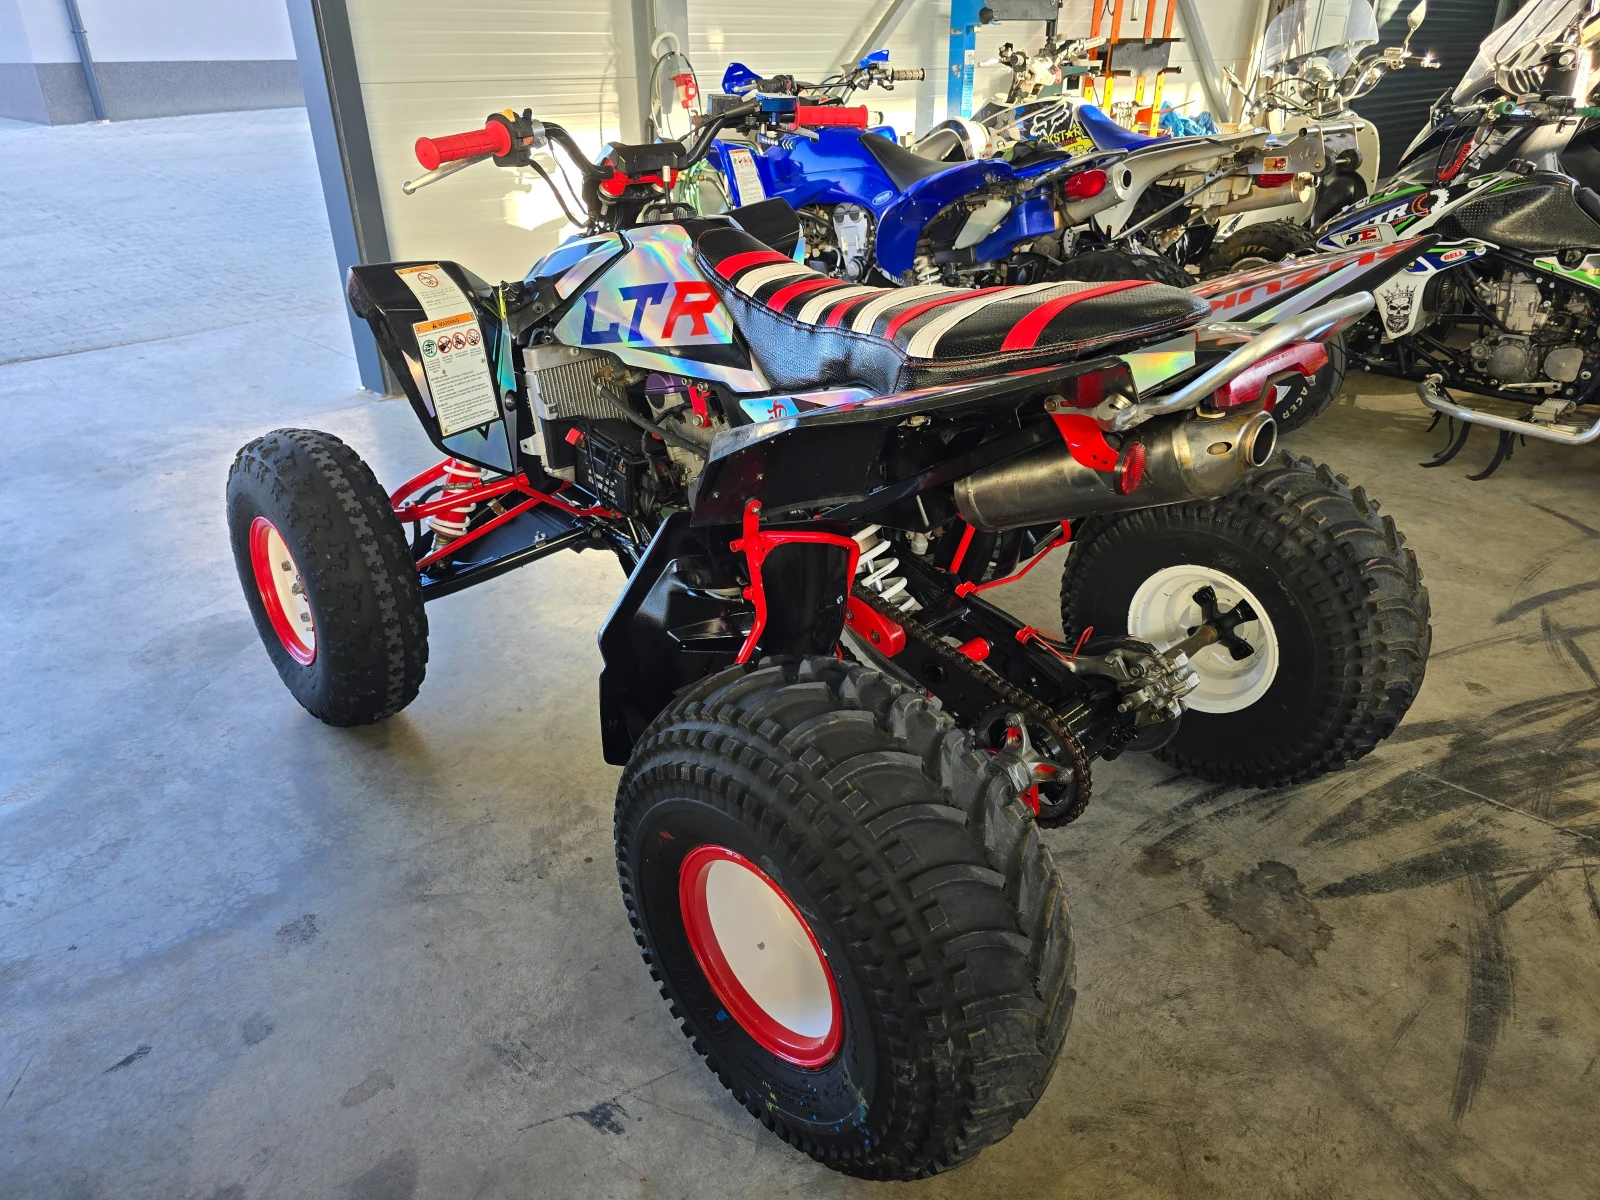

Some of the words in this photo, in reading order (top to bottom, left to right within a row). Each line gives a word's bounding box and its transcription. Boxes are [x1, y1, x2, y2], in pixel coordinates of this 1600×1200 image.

[1345, 229, 1378, 246] JE
[1443, 250, 1465, 261] BELL
[1209, 236, 1424, 312] SUZUK
[581, 281, 722, 345] LTR
